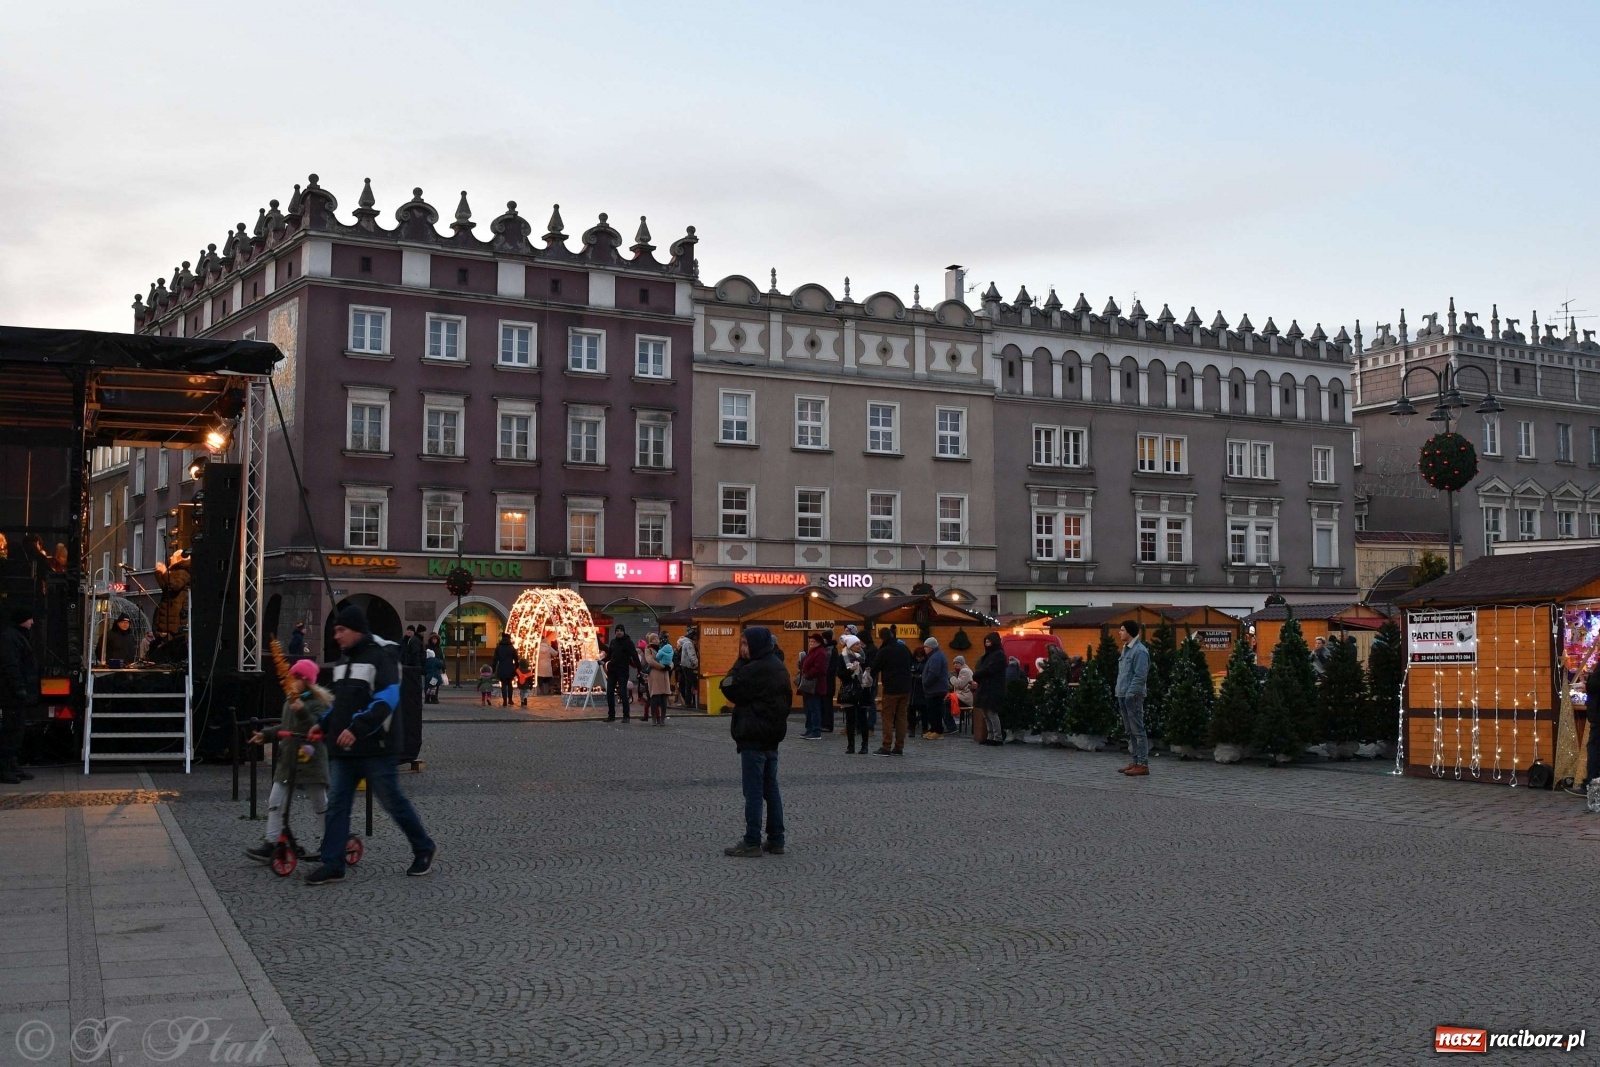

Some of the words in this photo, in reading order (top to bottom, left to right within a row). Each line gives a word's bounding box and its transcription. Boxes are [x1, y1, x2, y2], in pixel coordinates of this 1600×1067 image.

[328, 556, 397, 567] TABAC
[428, 558, 522, 578] KANTOR
[734, 572, 807, 585] RESTAURACJA
[828, 574, 873, 588] SHIRO
[784, 620, 812, 630] GRZANE
[816, 620, 835, 629] WINO
[1412, 631, 1453, 640] PARTNER
